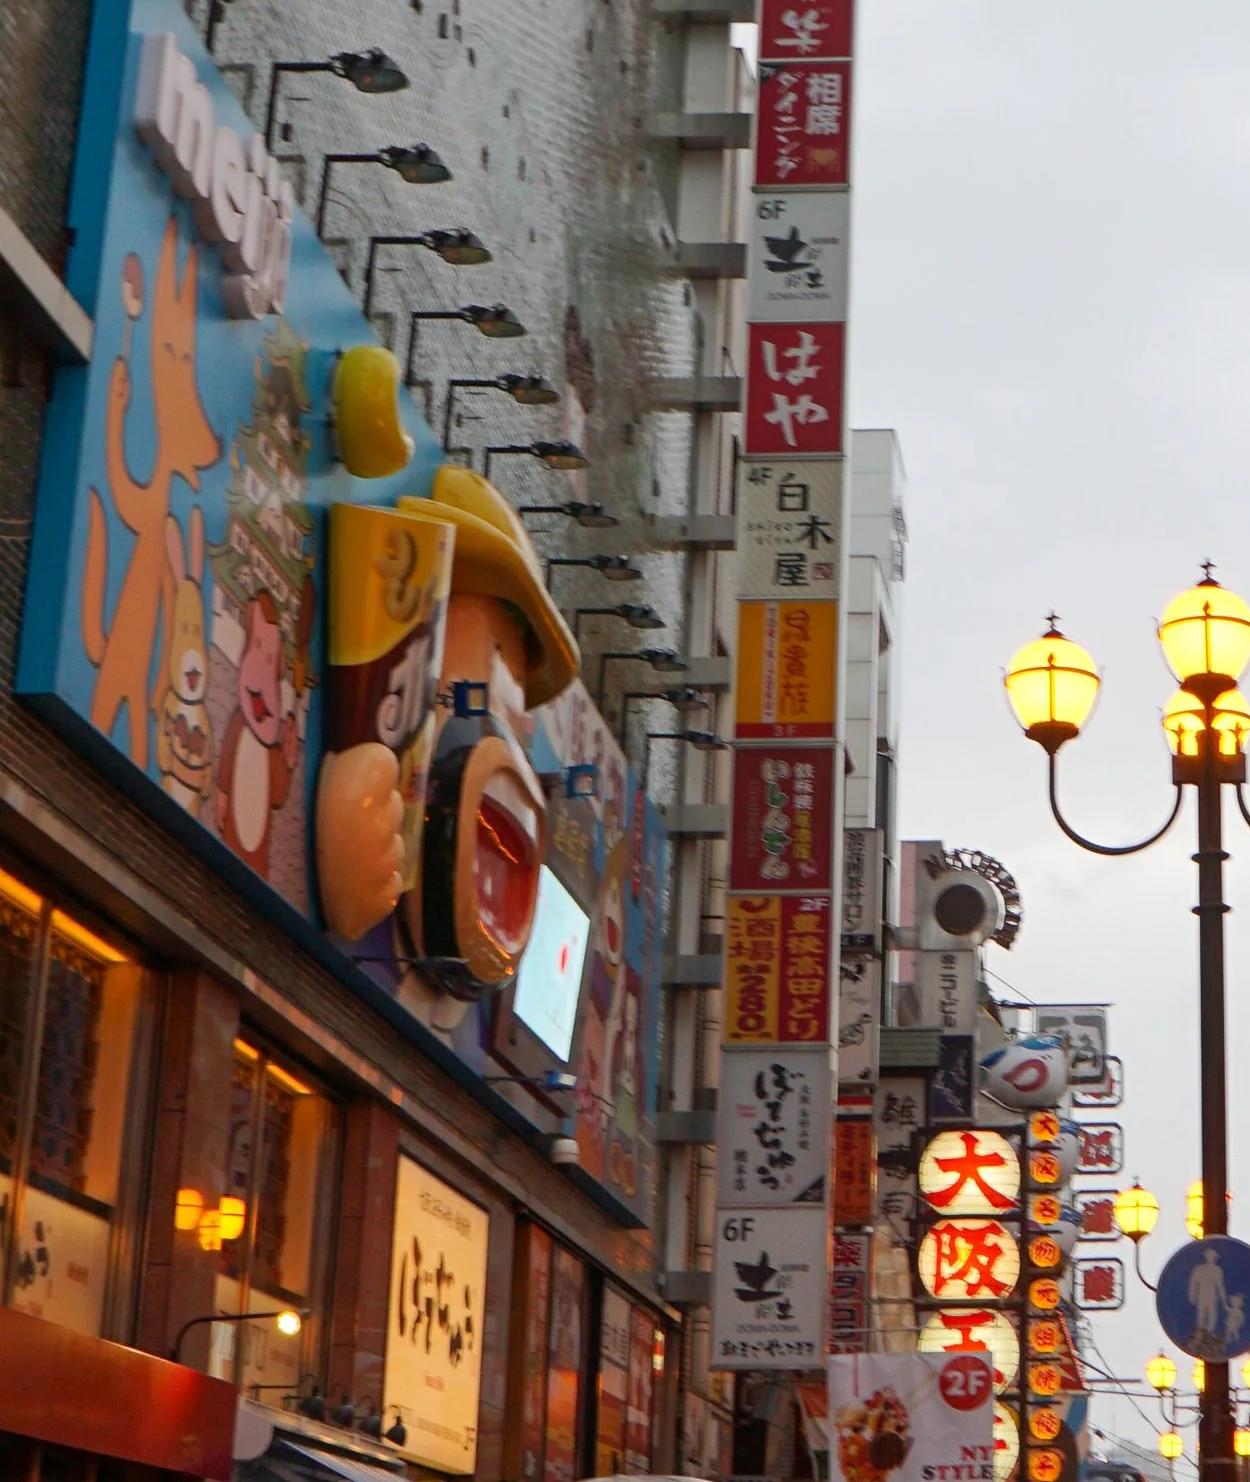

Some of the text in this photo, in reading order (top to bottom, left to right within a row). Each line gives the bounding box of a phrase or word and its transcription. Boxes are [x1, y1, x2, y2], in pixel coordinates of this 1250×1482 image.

[137, 31, 295, 320] meiji
[757, 200, 788, 220] 6F
[761, 330, 829, 447] はや
[774, 472, 836, 587] 白木屋
[722, 1217, 755, 1242] 6F
[947, 1370, 988, 1396] 2F
[959, 1445, 993, 1461] NY
[922, 1465, 993, 1480] STYLE
